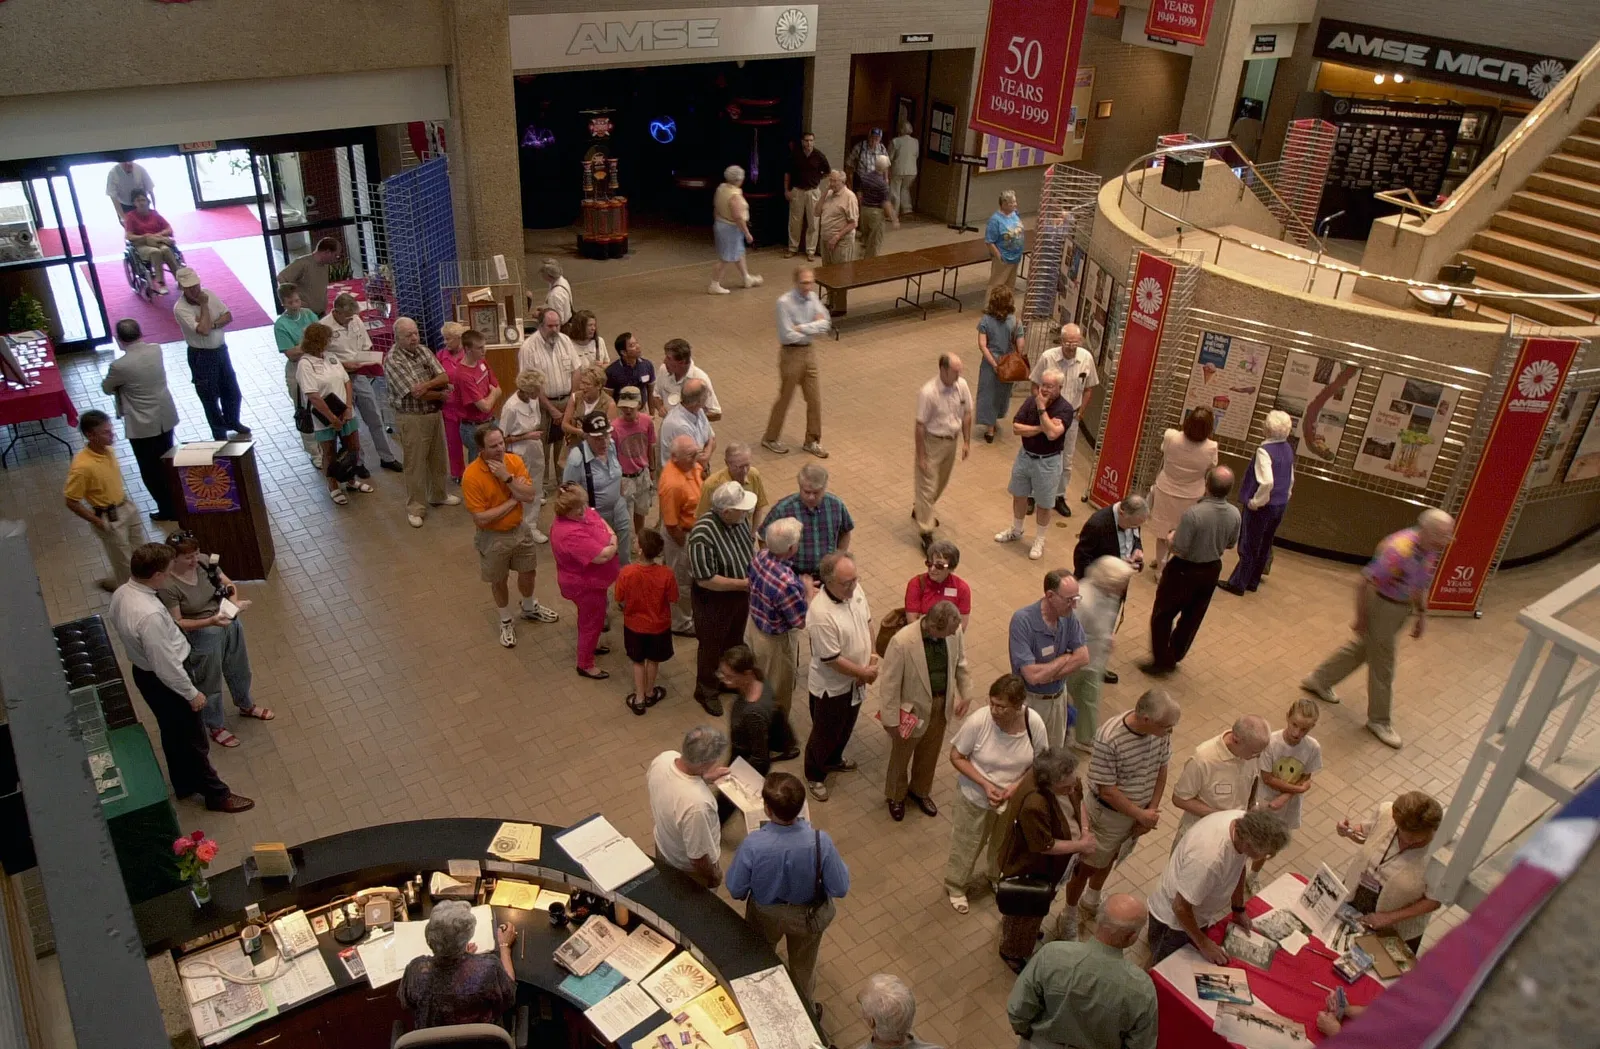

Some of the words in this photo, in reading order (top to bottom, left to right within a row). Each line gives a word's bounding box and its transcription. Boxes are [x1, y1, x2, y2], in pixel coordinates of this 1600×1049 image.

[1164, 0, 1195, 14] YEARS
[1157, 11, 1197, 27] 1949-1999
[565, 18, 721, 55] AMSE
[1004, 36, 1043, 80] 50
[1327, 31, 1431, 67] AMSE
[999, 76, 1044, 103] YEARS
[990, 95, 1050, 125] 1949-1999
[1350, 107, 1385, 116] EXPANDING
[1102, 465, 1118, 484] 50
[1451, 565, 1475, 581] 50
[1446, 579, 1473, 587] YEARS
